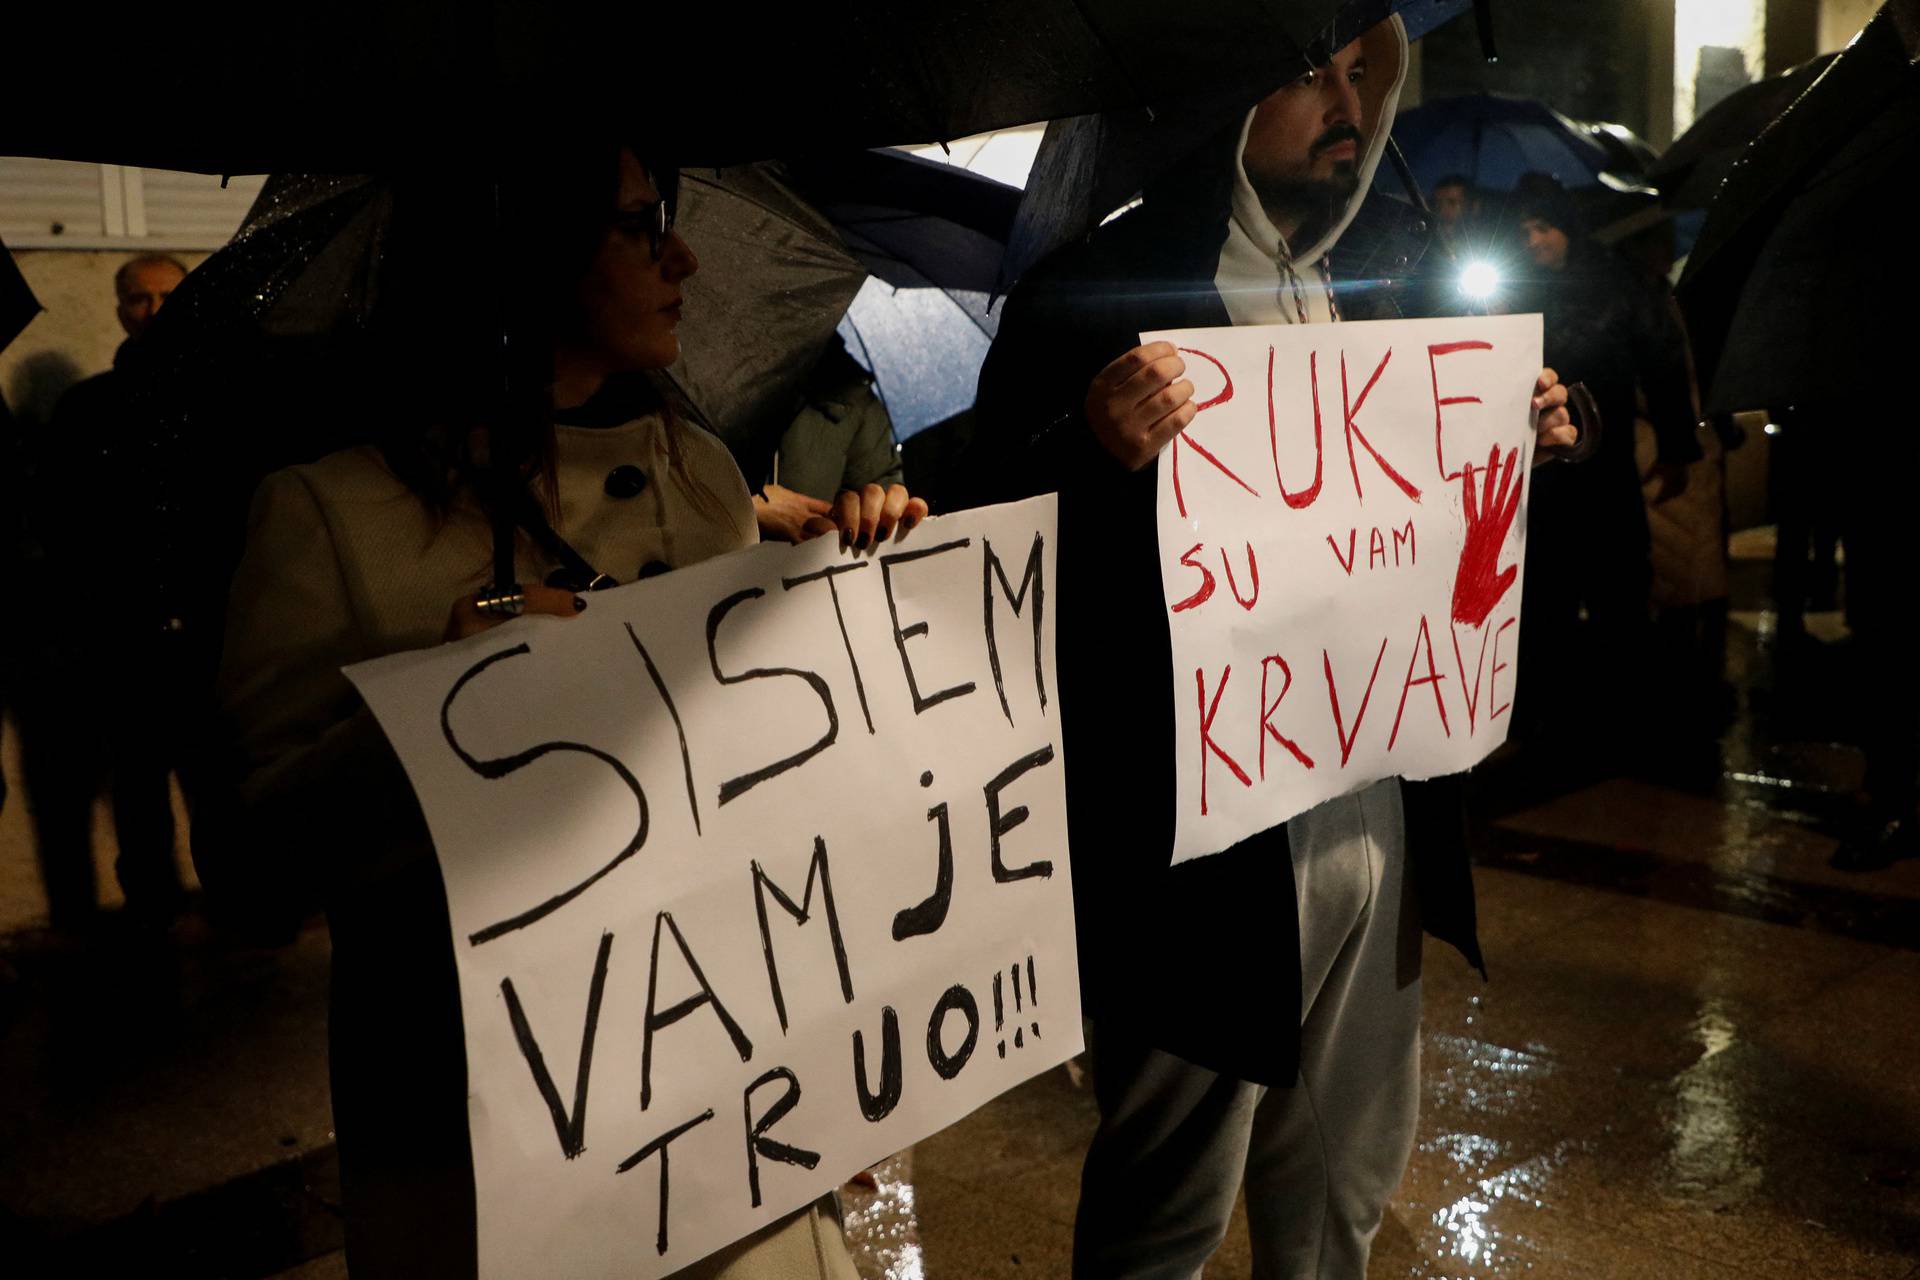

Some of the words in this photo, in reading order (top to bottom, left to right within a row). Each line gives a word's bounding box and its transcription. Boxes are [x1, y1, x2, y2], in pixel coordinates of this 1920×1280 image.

[1172, 341, 1504, 518] RUKE
[1171, 542, 1260, 613] SU
[1326, 519, 1416, 575] VAM
[442, 531, 1047, 946] SISTEM
[1196, 614, 1517, 816] KRVAVE
[500, 835, 854, 1160] VAM
[616, 956, 1042, 1256] TRUO!!!
